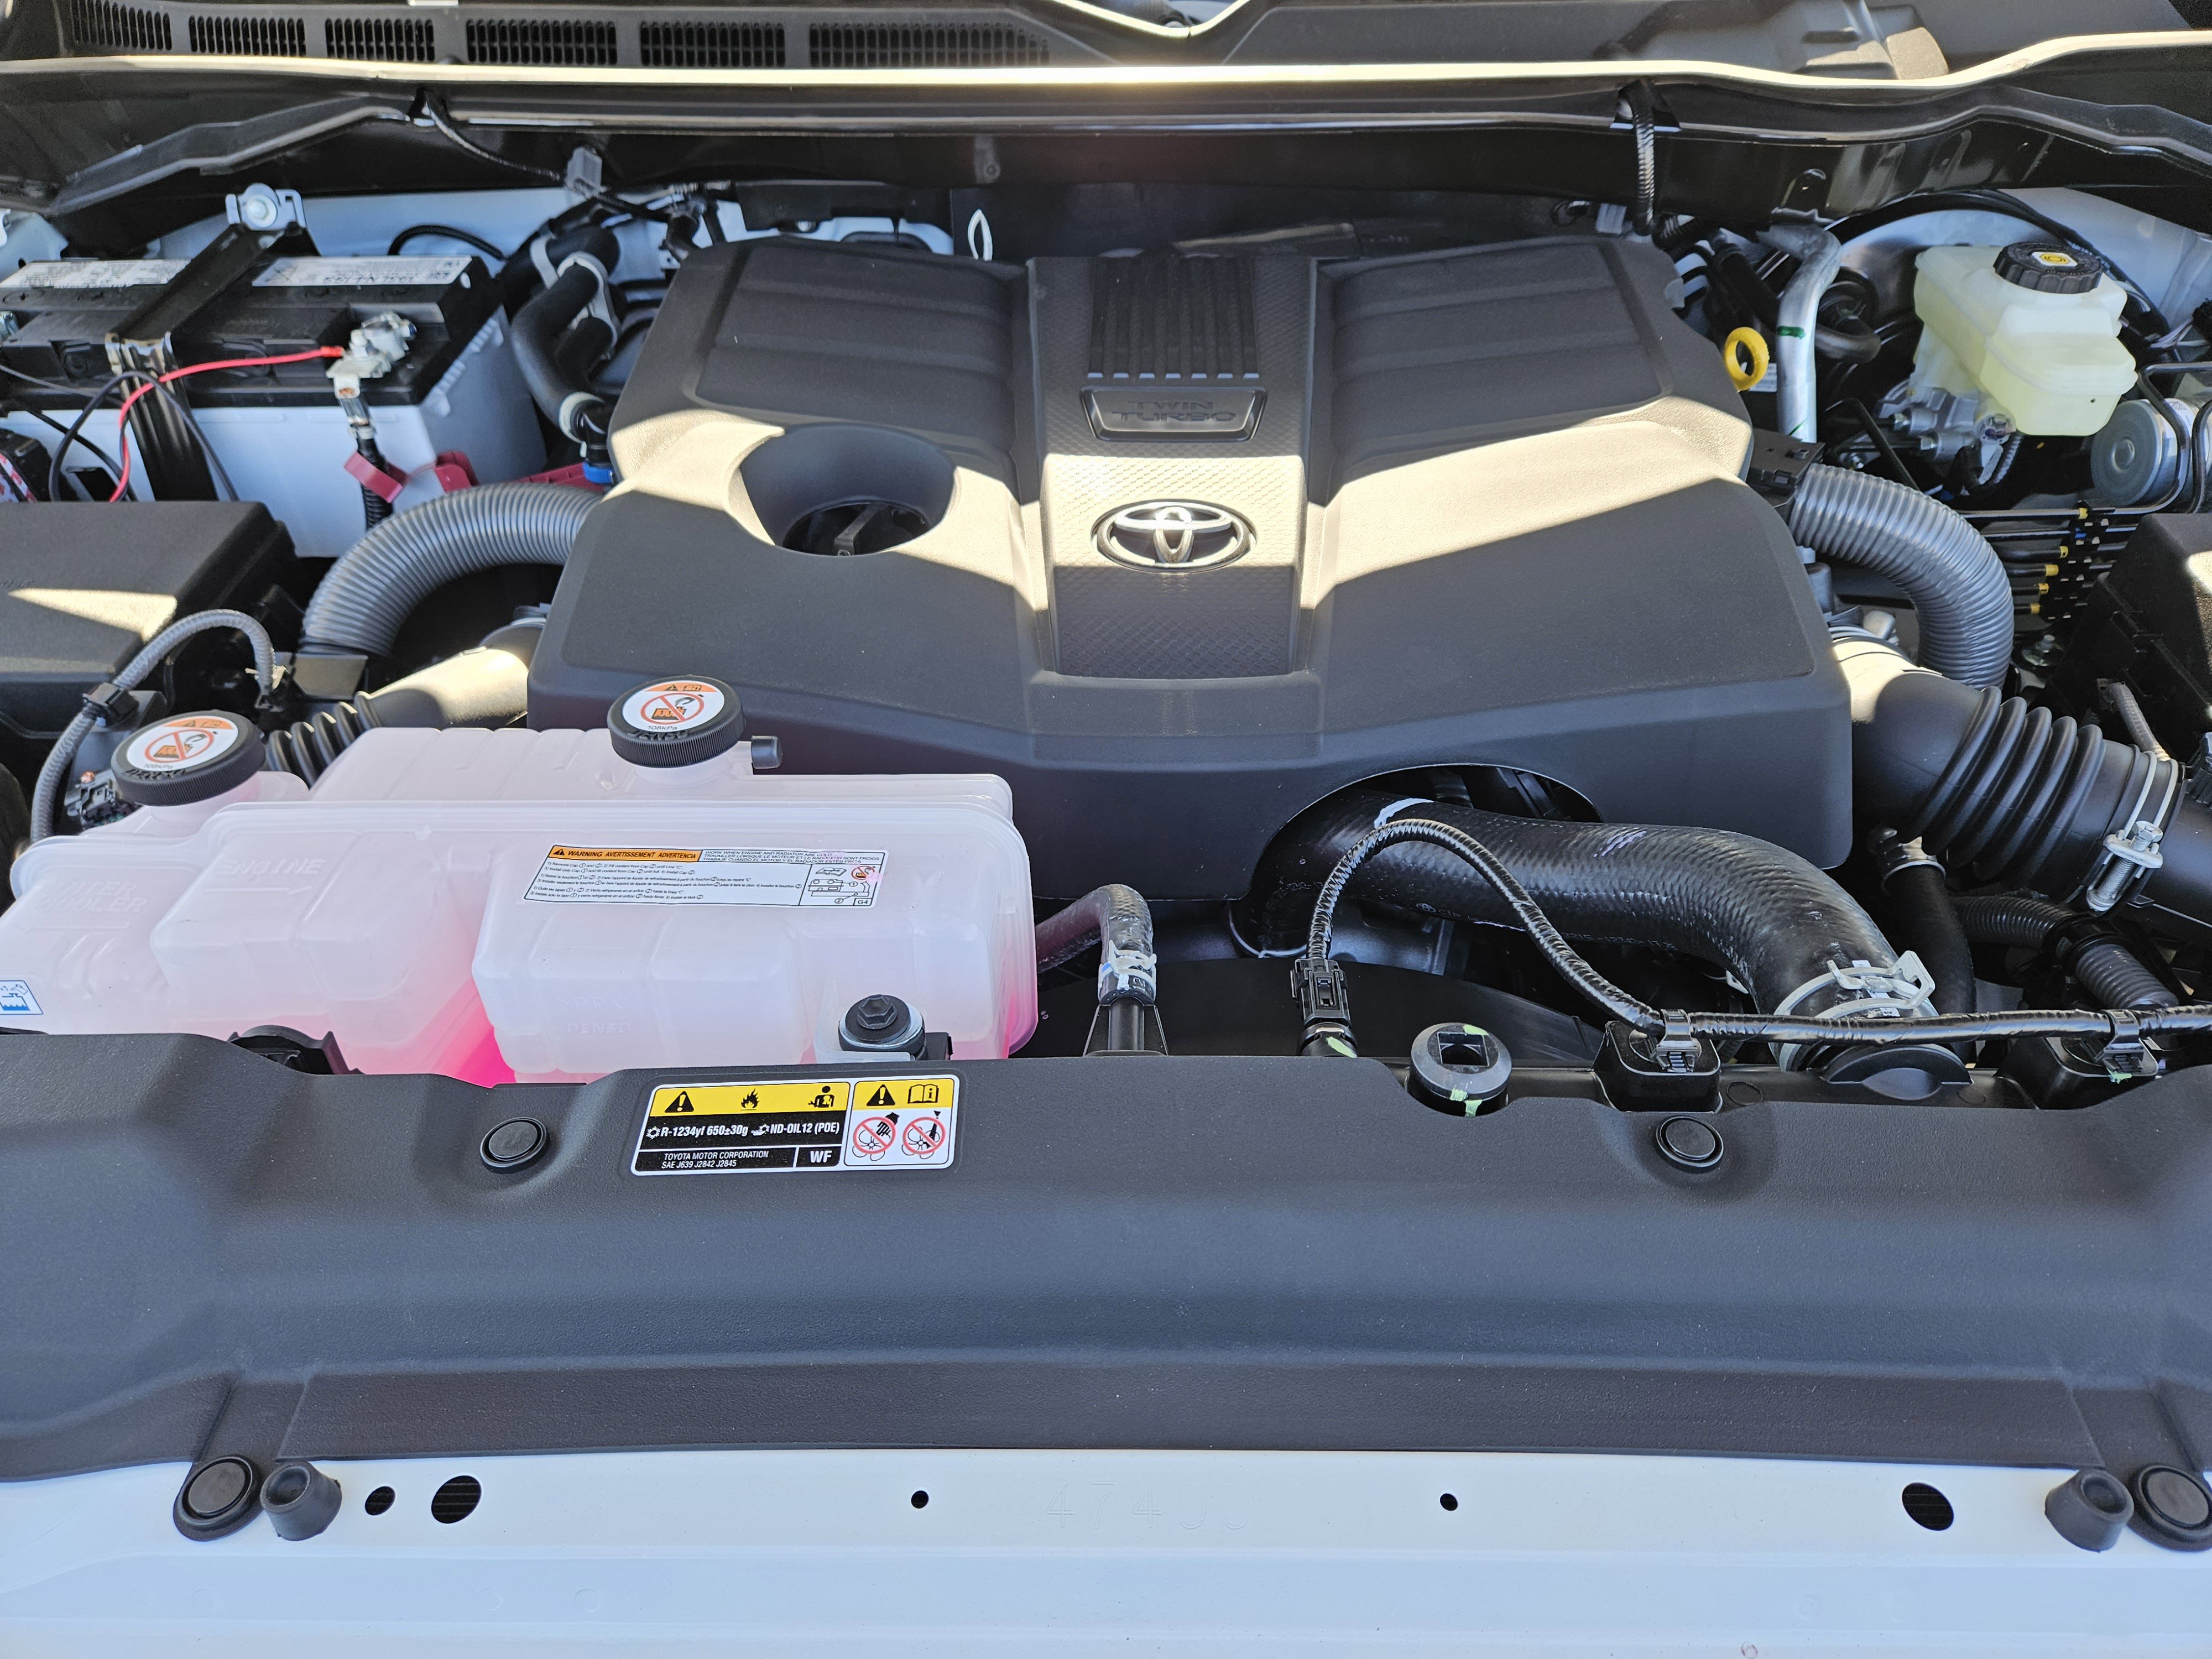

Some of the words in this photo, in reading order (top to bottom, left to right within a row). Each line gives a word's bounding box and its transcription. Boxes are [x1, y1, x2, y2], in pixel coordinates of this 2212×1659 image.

[1128, 401, 1213, 410] TWIN
[1112, 411, 1237, 421] TURBO
[566, 1021, 631, 1034] DENSO
[660, 1125, 705, 1138] R-1234yf
[707, 1125, 748, 1136] 650±30g
[814, 1122, 840, 1135] (POE)
[664, 1152, 691, 1160] TOYOTA
[692, 1151, 718, 1160] MOTOR
[719, 1150, 769, 1159] CORPORATION
[810, 1150, 832, 1163] WF
